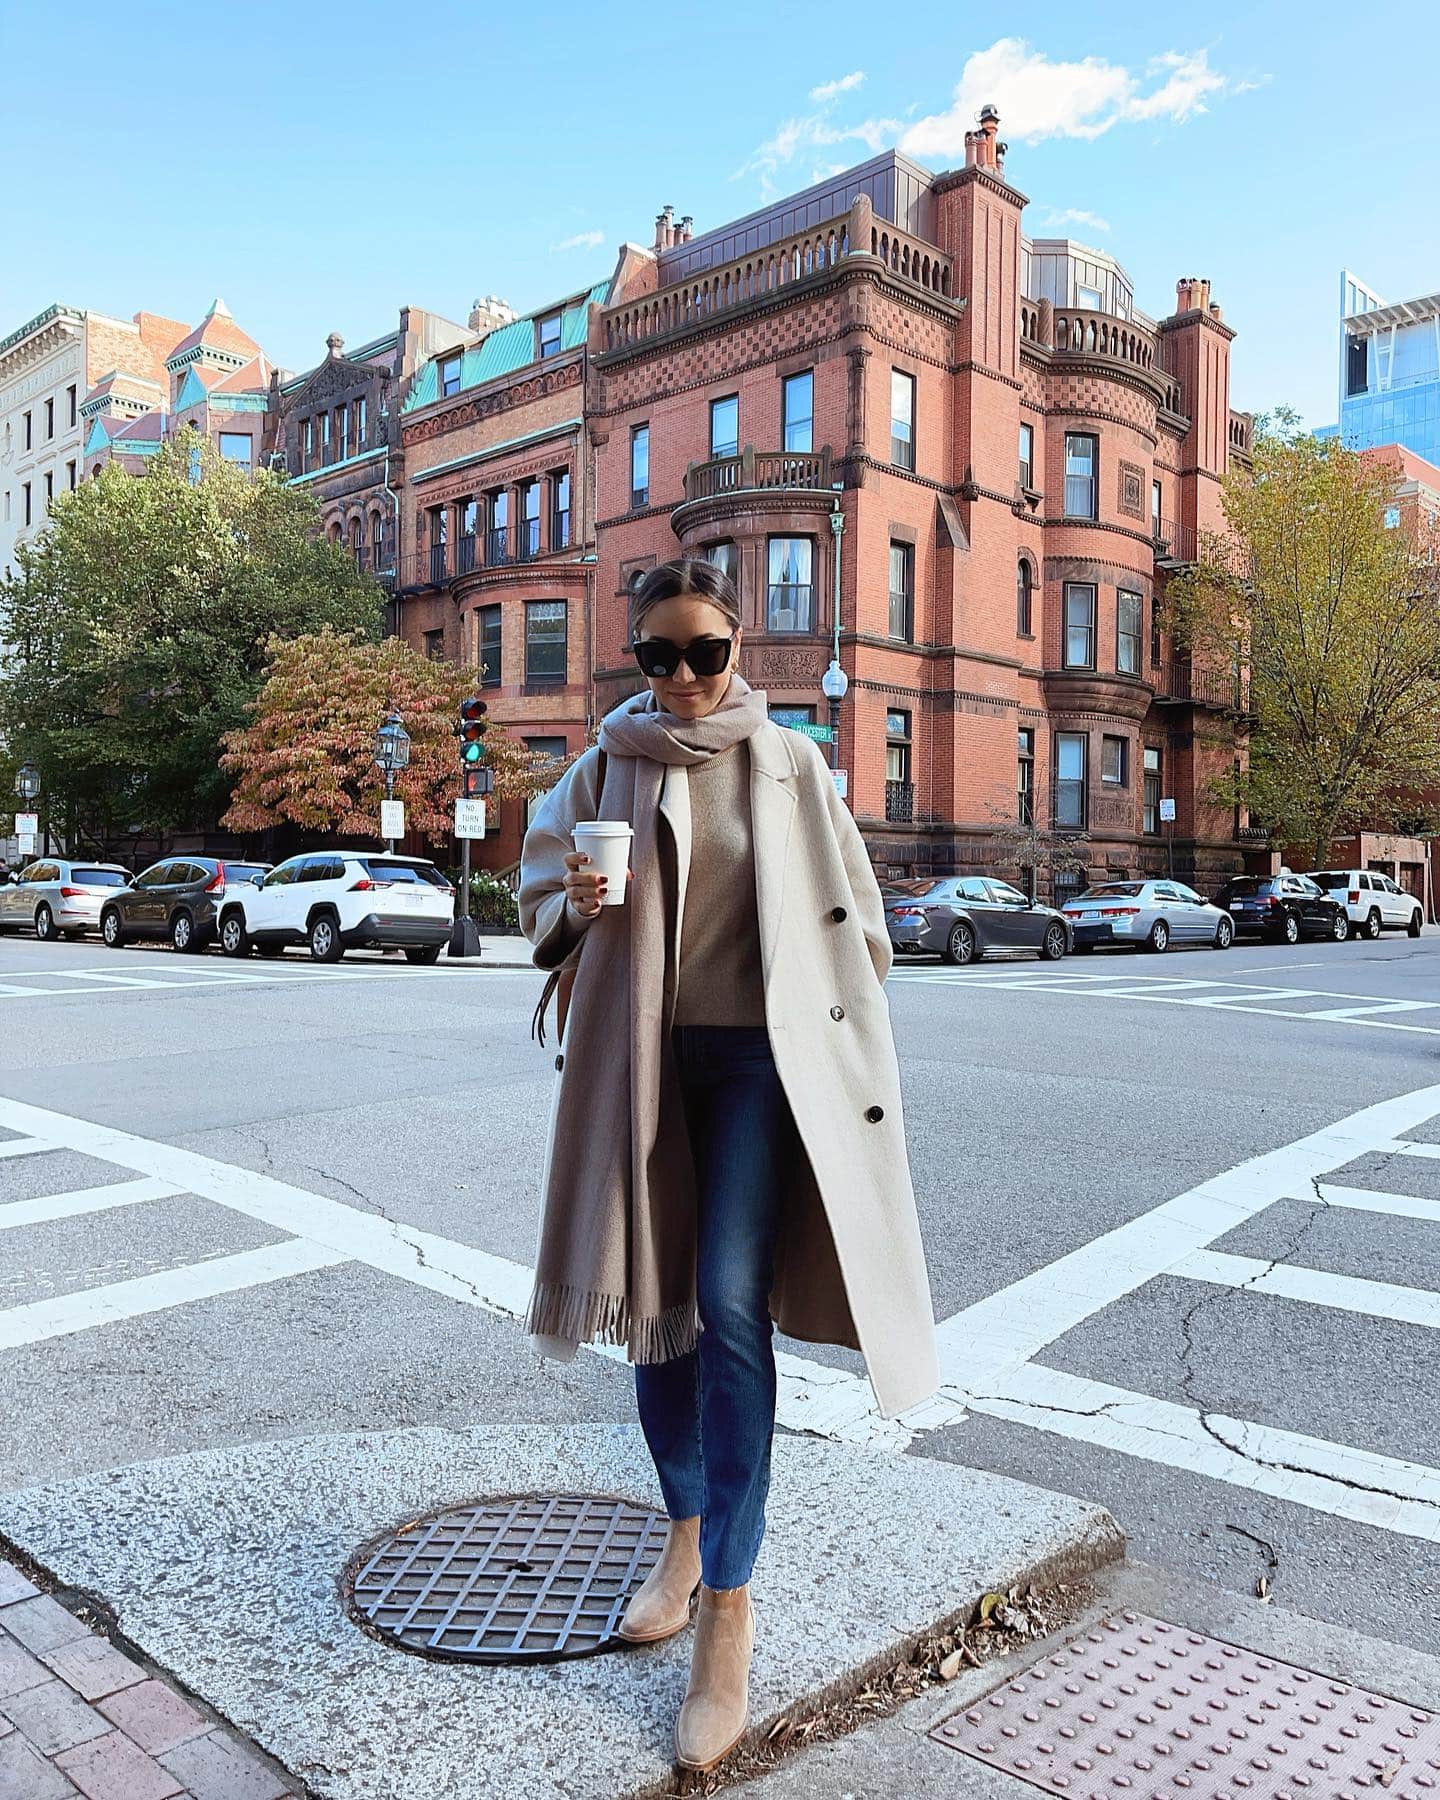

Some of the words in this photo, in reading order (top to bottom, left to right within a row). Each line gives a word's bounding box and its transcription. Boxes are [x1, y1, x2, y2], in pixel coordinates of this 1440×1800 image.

[465, 804, 475, 812] NO
[462, 814, 479, 822] TURN
[457, 824, 467, 833] ON
[469, 824, 482, 833] RED
